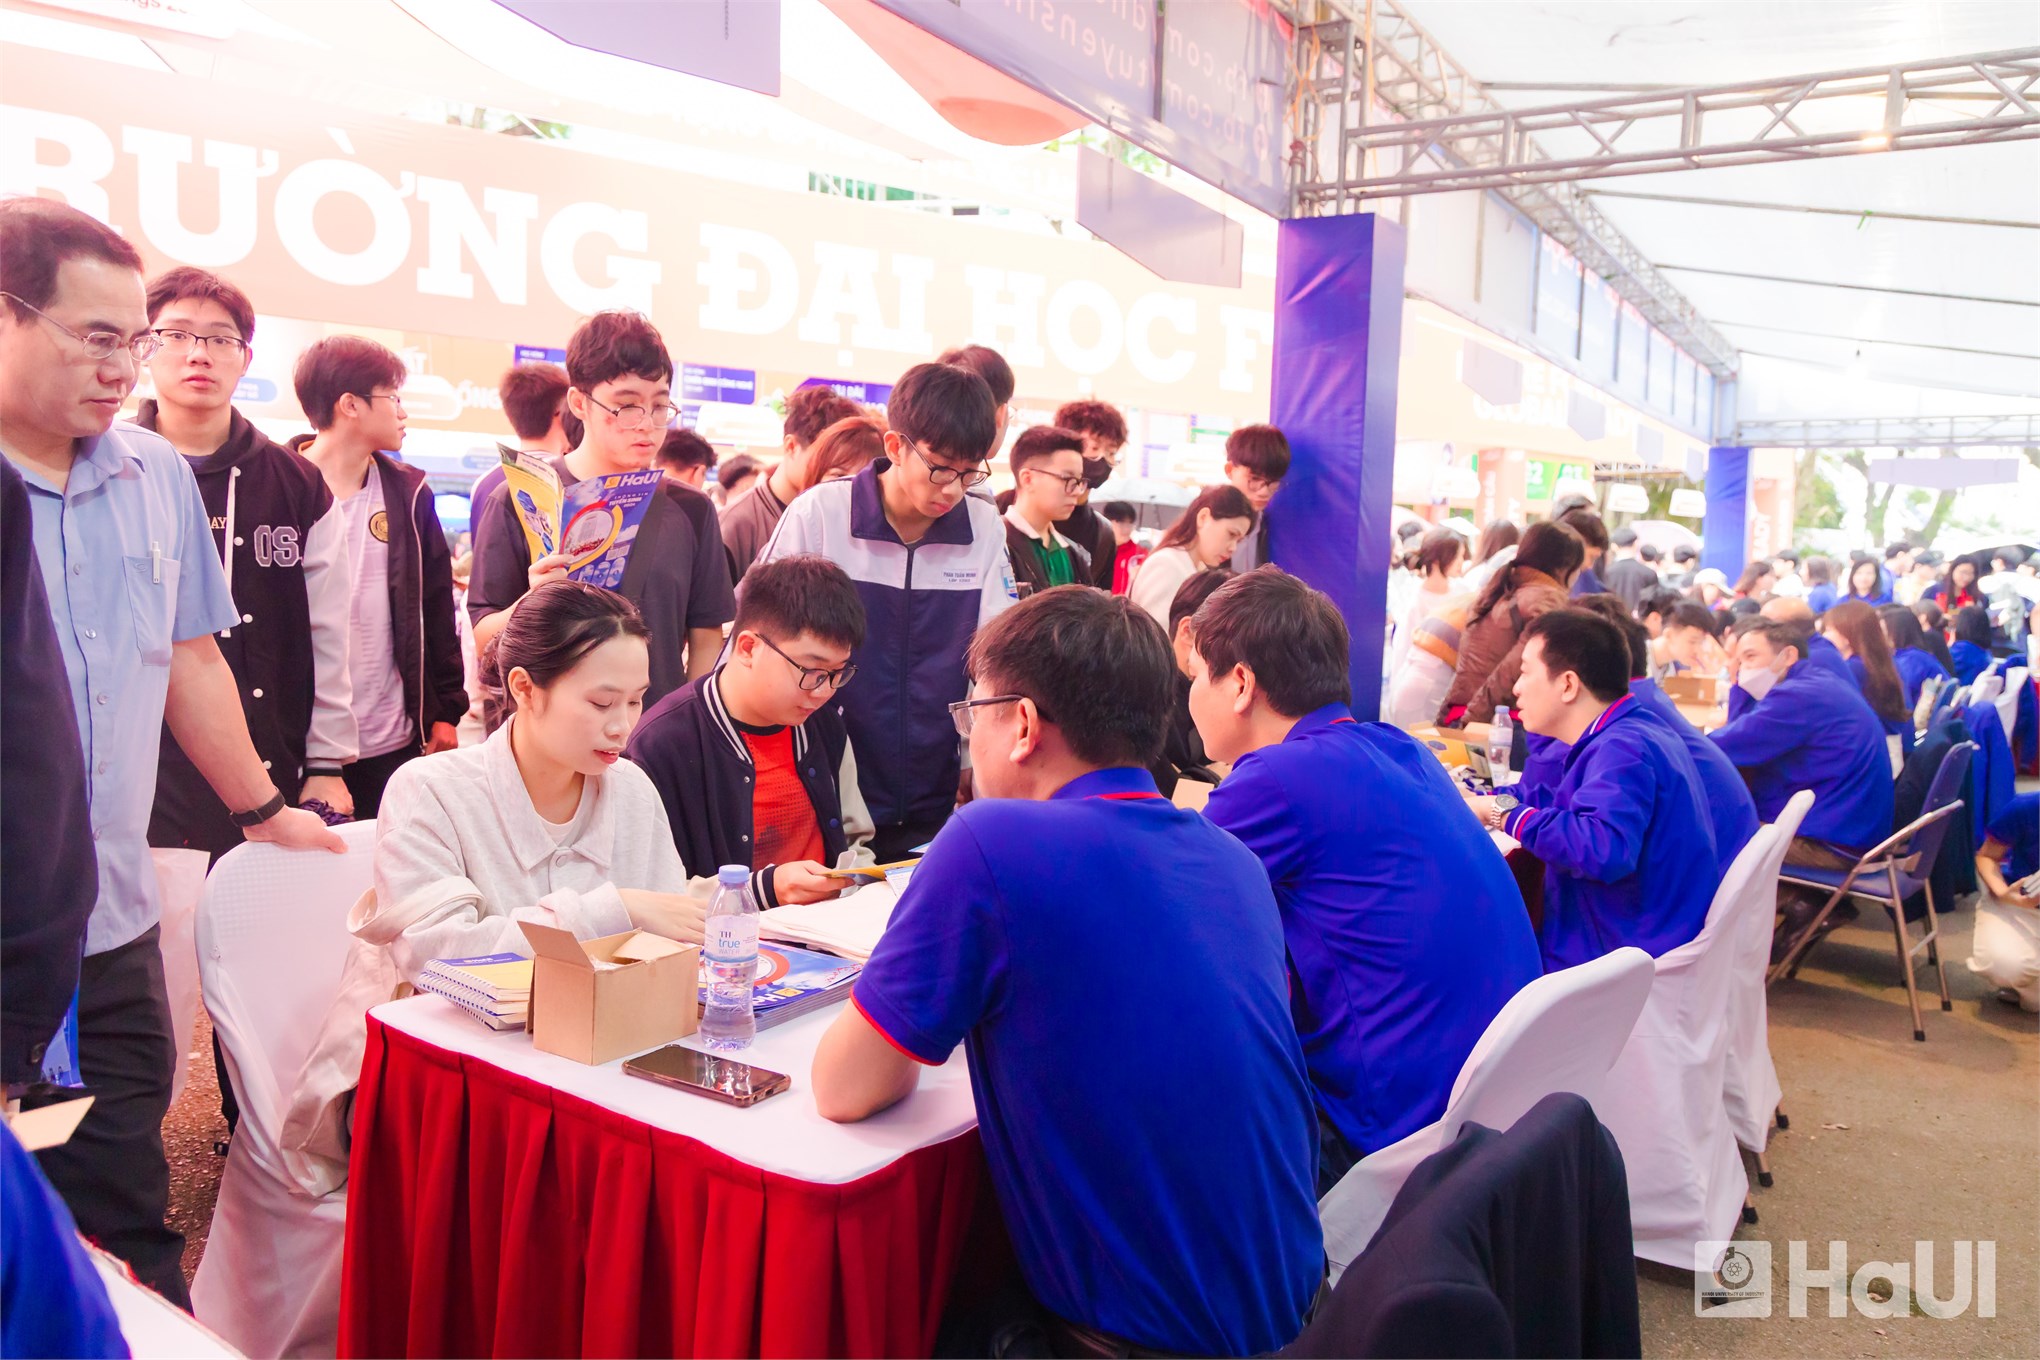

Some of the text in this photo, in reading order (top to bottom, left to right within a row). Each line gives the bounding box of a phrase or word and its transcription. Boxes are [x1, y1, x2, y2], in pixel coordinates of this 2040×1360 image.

[697, 222, 934, 367] ĐẠI
[965, 264, 1198, 393] HỌC
[620, 471, 661, 487] HaUI
[208, 516, 228, 529] AY
[719, 939, 740, 948] true
